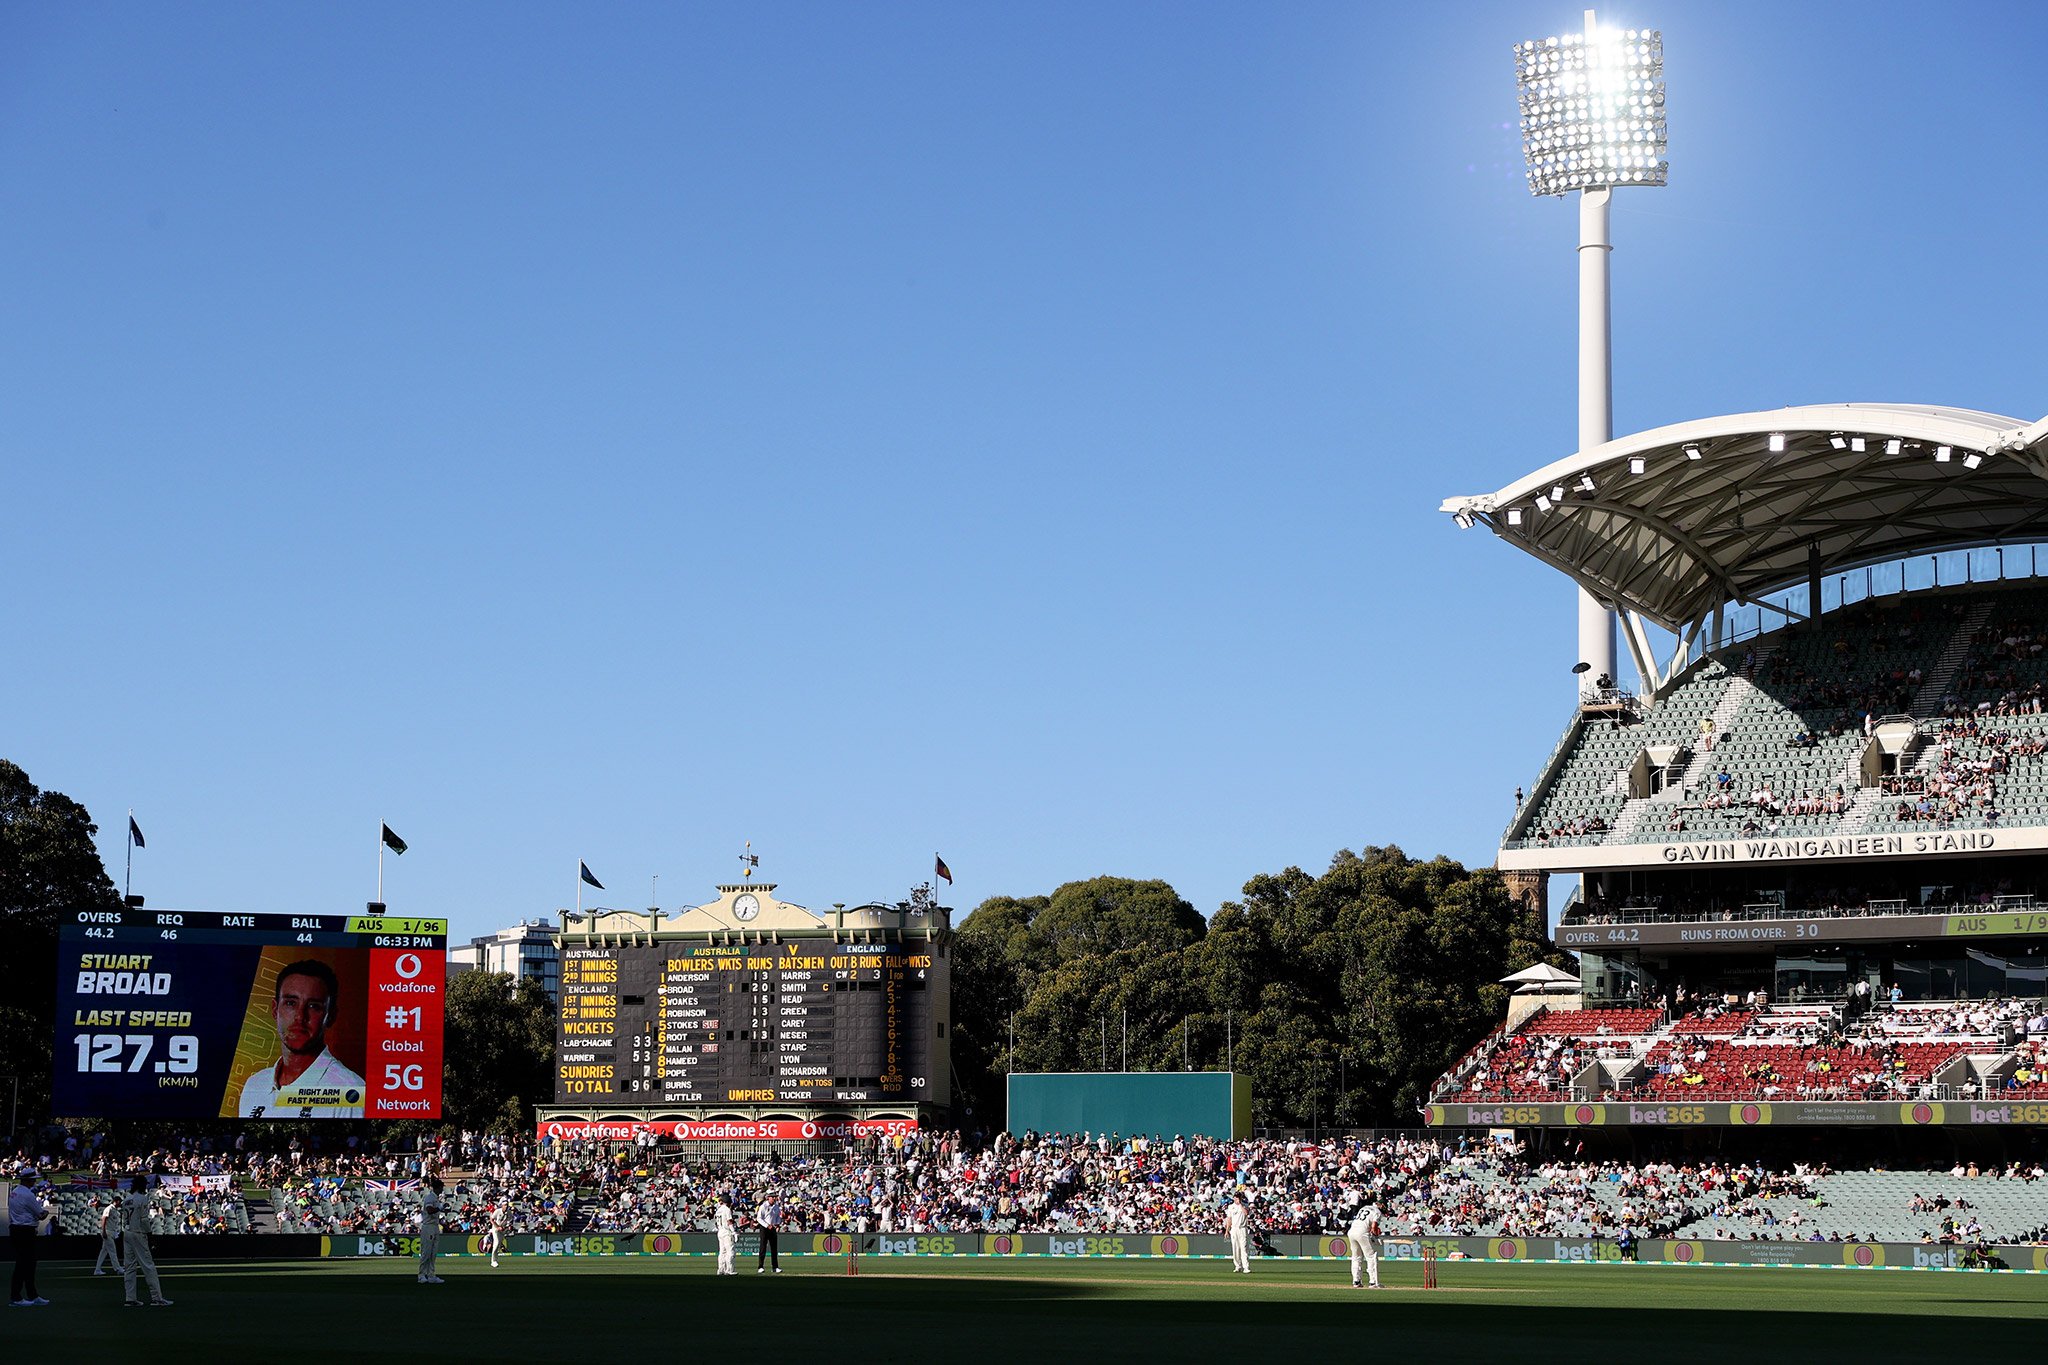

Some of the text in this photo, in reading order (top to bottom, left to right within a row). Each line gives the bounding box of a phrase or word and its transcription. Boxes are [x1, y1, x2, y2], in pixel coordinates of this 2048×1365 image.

[1662, 833, 1994, 861] GAVIN WANGANEEN STAND
[78, 912, 121, 923] OVERS
[157, 914, 183, 926] REQ
[223, 916, 255, 927] RATE
[292, 918, 321, 929] BALL
[357, 919, 383, 931] AUS
[1566, 933, 1599, 942] OVER:
[1608, 930, 1639, 941] 44.2
[1681, 930, 1712, 940] RUNS
[1715, 929, 1749, 939] FROM
[1752, 928, 1786, 938] OVER:
[1957, 919, 1987, 931] AUS
[85, 928, 433, 947] 44.2 46 44 06:33 PM
[788, 945, 799, 955] V
[847, 945, 886, 953] ENGLAND
[81, 954, 152, 969] STUART
[564, 960, 617, 972] 1ST INNINGS
[668, 957, 773, 972] BOWLERS WKTS RUNS
[779, 957, 824, 969] BATSMEN
[831, 956, 848, 968] OUT
[851, 956, 857, 968] B
[860, 956, 882, 968] RUNS
[886, 956, 902, 967] FALL
[909, 956, 931, 968] WKTS
[563, 972, 617, 983] 2ND INNINGS
[660, 973, 665, 982] 1
[668, 974, 709, 982] ANDERSON
[836, 971, 848, 979] CW
[850, 970, 857, 979] 2
[874, 970, 880, 979] 3
[918, 970, 925, 978] 4
[76, 972, 171, 995] BROAD
[380, 983, 436, 993] vodafone
[781, 984, 806, 992] SMITH
[568, 986, 608, 994] ENGLAND
[668, 986, 693, 994] BROAD
[564, 996, 616, 1006] 1ST INNINGS
[659, 997, 667, 1006] 3
[667, 997, 698, 1006] WOAKES
[75, 1010, 191, 1027] LAST SPEED
[385, 1006, 421, 1031] #1
[562, 1007, 616, 1019] 2ND INNINGS
[659, 1009, 667, 1018] 4
[667, 1009, 706, 1017] ROBINSON
[563, 1022, 614, 1034] WICKETS
[659, 1021, 667, 1031] 5
[667, 1021, 698, 1029] STOKES
[564, 1039, 612, 1047] LAB'CHAGNE
[658, 1032, 666, 1042] 6
[667, 1033, 687, 1041] ROOT
[382, 1039, 423, 1052] Global
[659, 1044, 666, 1054] 7
[666, 1045, 692, 1053] MALAN
[74, 1034, 199, 1073] 127.9
[780, 1055, 800, 1063] LYON
[658, 1056, 697, 1066] 8 HAMEED
[560, 1066, 614, 1078] SUNDRIES
[657, 1068, 686, 1078] 9 POPE
[780, 1067, 827, 1075] RICHARDSON
[158, 1076, 198, 1088] (KM/H)
[384, 1065, 423, 1090] 5G
[781, 1079, 797, 1087] AUS
[911, 1077, 925, 1087] 90
[565, 1081, 613, 1093] TOTAL
[665, 1093, 702, 1101] BUTTLER
[728, 1090, 774, 1100] UMPIRES
[377, 1098, 430, 1110] Network
[1467, 1106, 1541, 1124] bet365
[1629, 1106, 1705, 1123] bet365
[1970, 1105, 2048, 1123] bet365
[563, 1125, 629, 1138] vodafone
[690, 1124, 778, 1137] vodafone 5G
[535, 1236, 615, 1253] bet365
[879, 1236, 955, 1253] bet365
[1050, 1237, 1124, 1254] bet365
[1555, 1241, 1635, 1259] bet36
